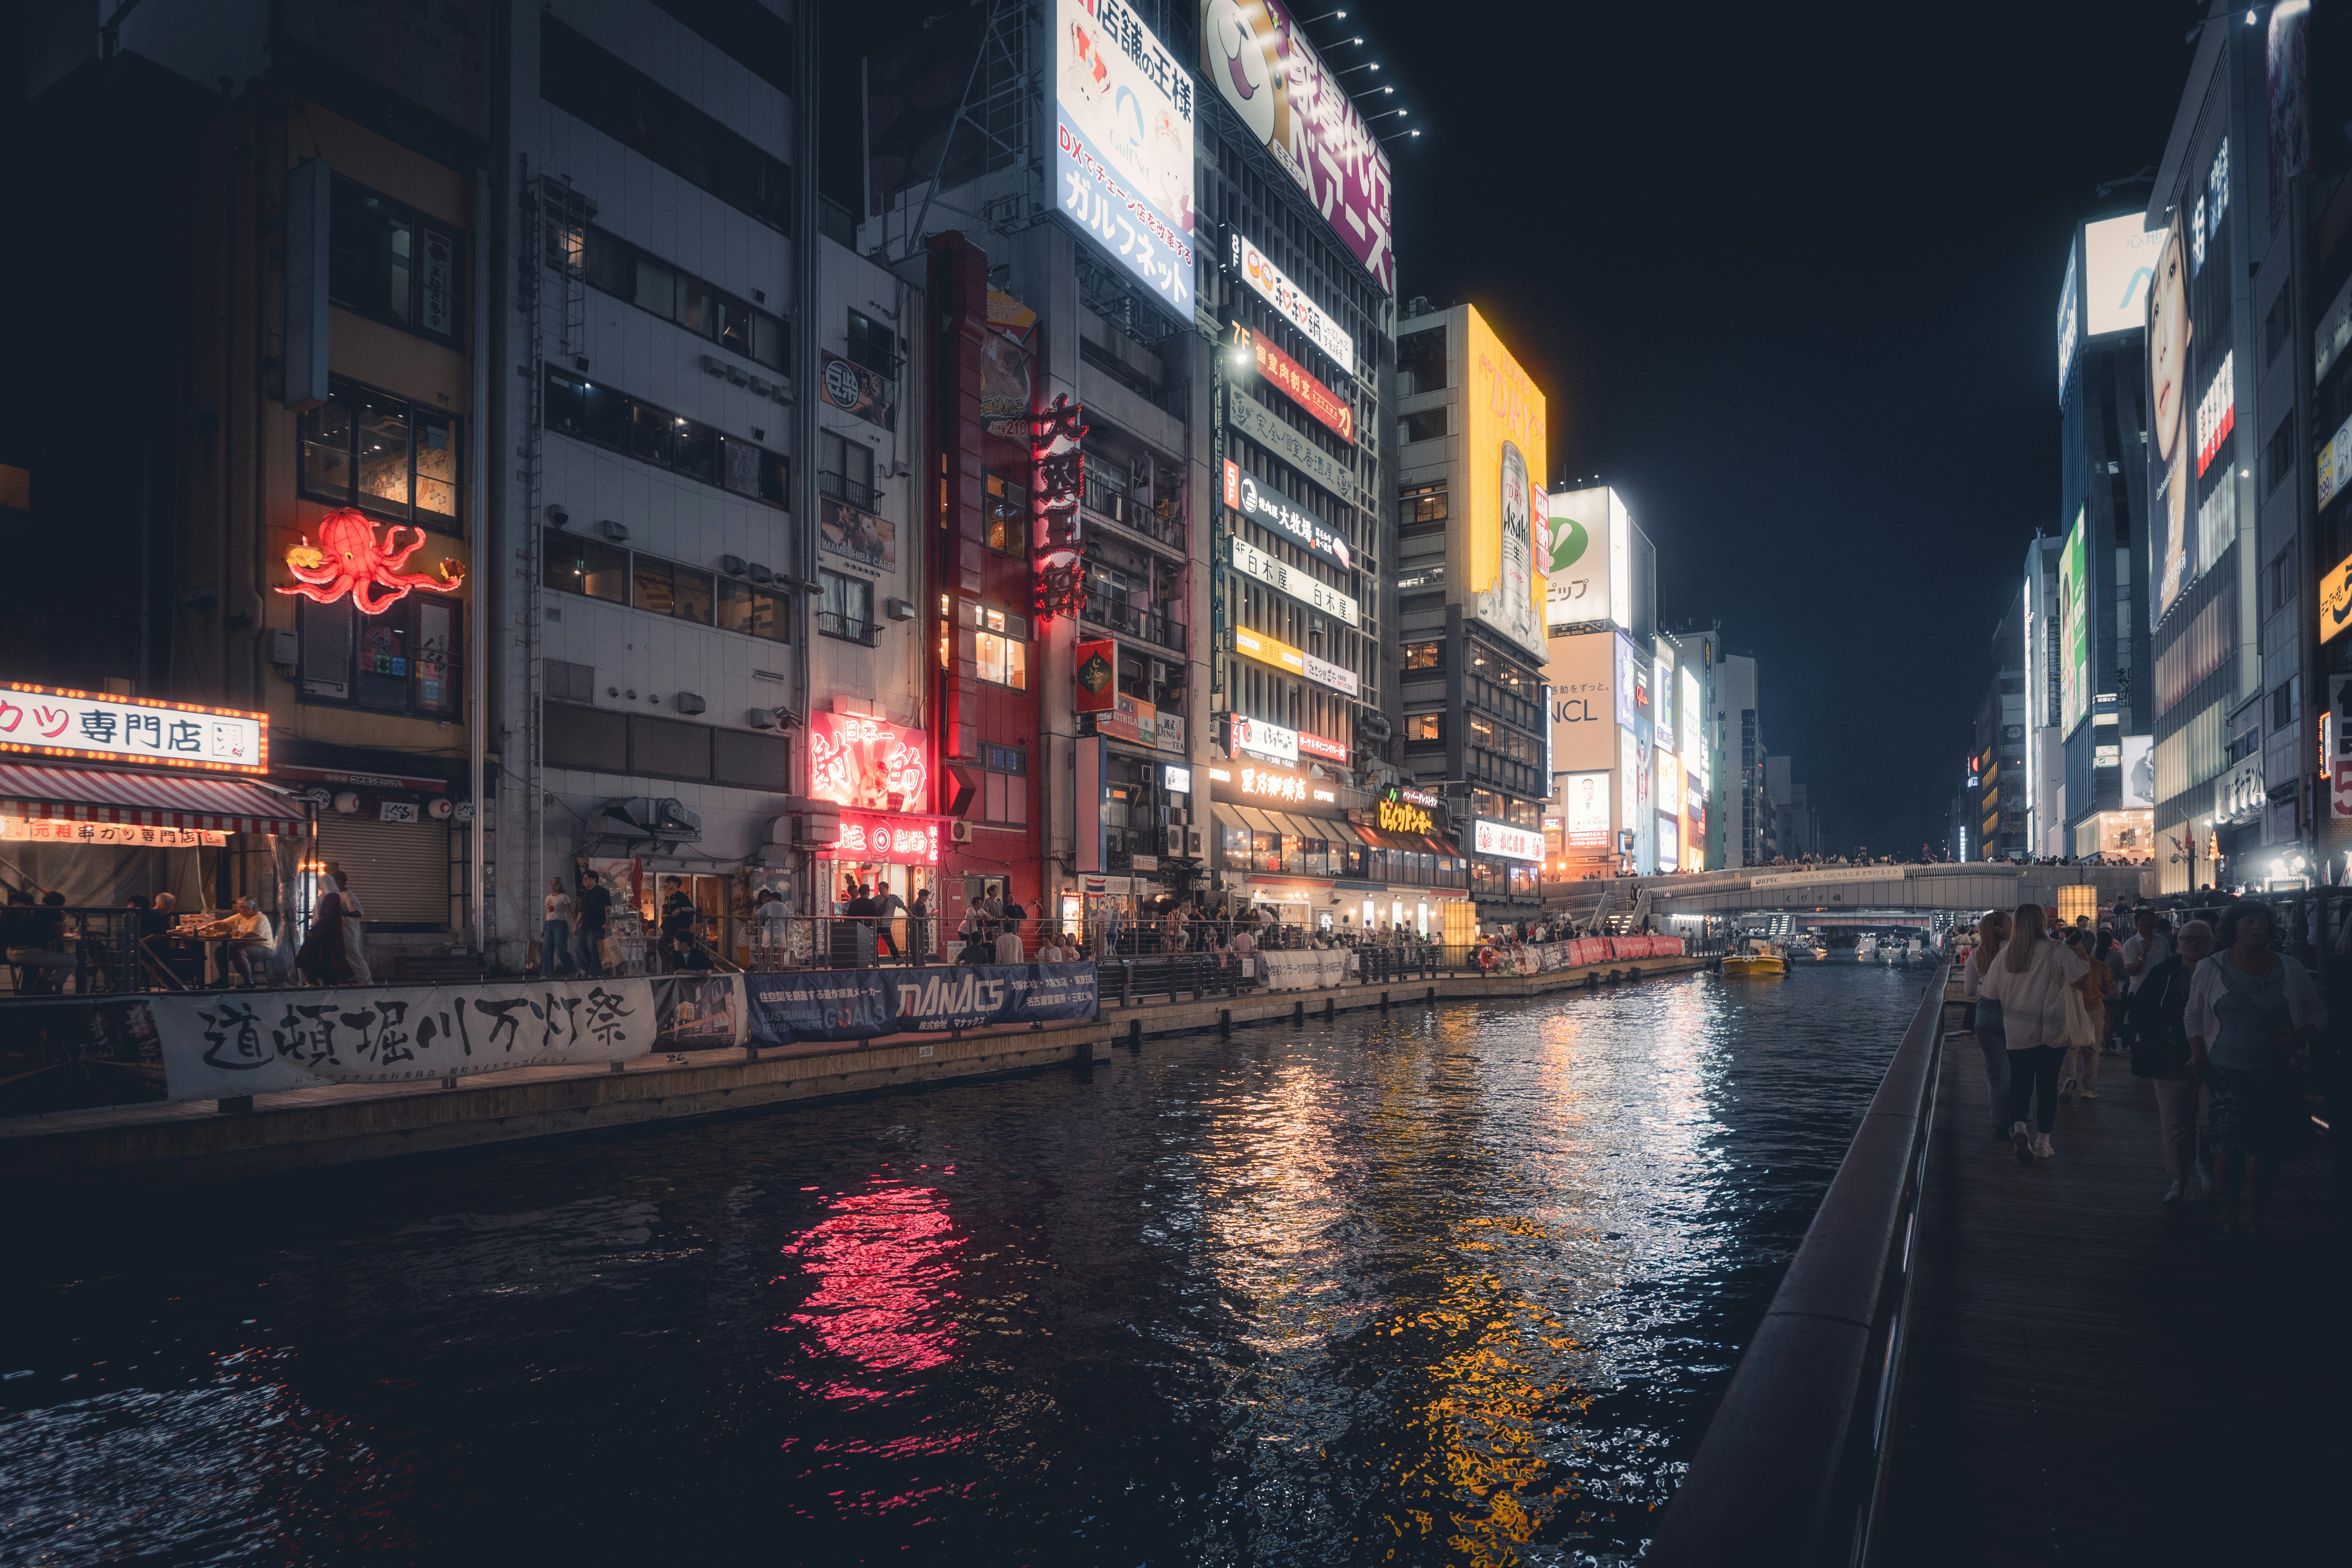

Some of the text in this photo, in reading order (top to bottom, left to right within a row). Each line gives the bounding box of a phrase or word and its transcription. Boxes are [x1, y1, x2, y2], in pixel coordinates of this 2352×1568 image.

[1078, 0, 1191, 123] 店舗の王様
[1060, 124, 1191, 265] DXでチェーン店を改革する
[1290, 104, 1391, 298] ベアーズ
[1065, 170, 1188, 303] ガルフネット
[1232, 234, 1239, 267] 8F
[1232, 320, 1250, 350] 7F
[1256, 343, 1310, 401] 個室肉割烹
[1501, 351, 1529, 398] SUPER
[1313, 393, 1338, 418] KATANA
[1257, 412, 1334, 484] 完全個室居酒屋
[1227, 466, 1236, 502] 5F
[1511, 477, 1521, 491] SUPER
[1535, 490, 1548, 522] ASAHI
[1279, 505, 1312, 543] 大牧場
[1504, 501, 1528, 551] Asahi
[1535, 520, 1548, 550] 1889
[824, 540, 892, 571] MAMESHIBA CAFE
[1236, 541, 1245, 555] 4F
[1513, 544, 1520, 561] 生
[1536, 545, 1549, 575] OSAKA
[1248, 549, 1288, 591] 白木屋
[1314, 583, 1347, 620] 白木屋
[846, 720, 895, 745] 日本一
[1112, 712, 1138, 727] MITHILA
[1157, 724, 1176, 740] DING
[1171, 741, 1184, 751] TEA
[1241, 768, 1306, 803] 星乃珈琲店
[1313, 789, 1334, 803] COFFEE
[1402, 789, 1438, 807] ハンバーグレストラン
[1380, 801, 1432, 835] びっくりドンキー
[33, 824, 197, 844] 元祖串カツ専門店
[1106, 882, 1128, 891] SINGHA
[1786, 892, 1841, 902] えびす橋
[760, 987, 881, 1002] 住空間を創造する造作家具メーカー
[196, 986, 637, 1070] 道頓堀川万灯祭
[760, 1009, 822, 1022] SUSTAINABLE
[763, 1021, 823, 1033] DEVELOPMENT
[918, 1016, 986, 1031] 株式会社 マナックス
